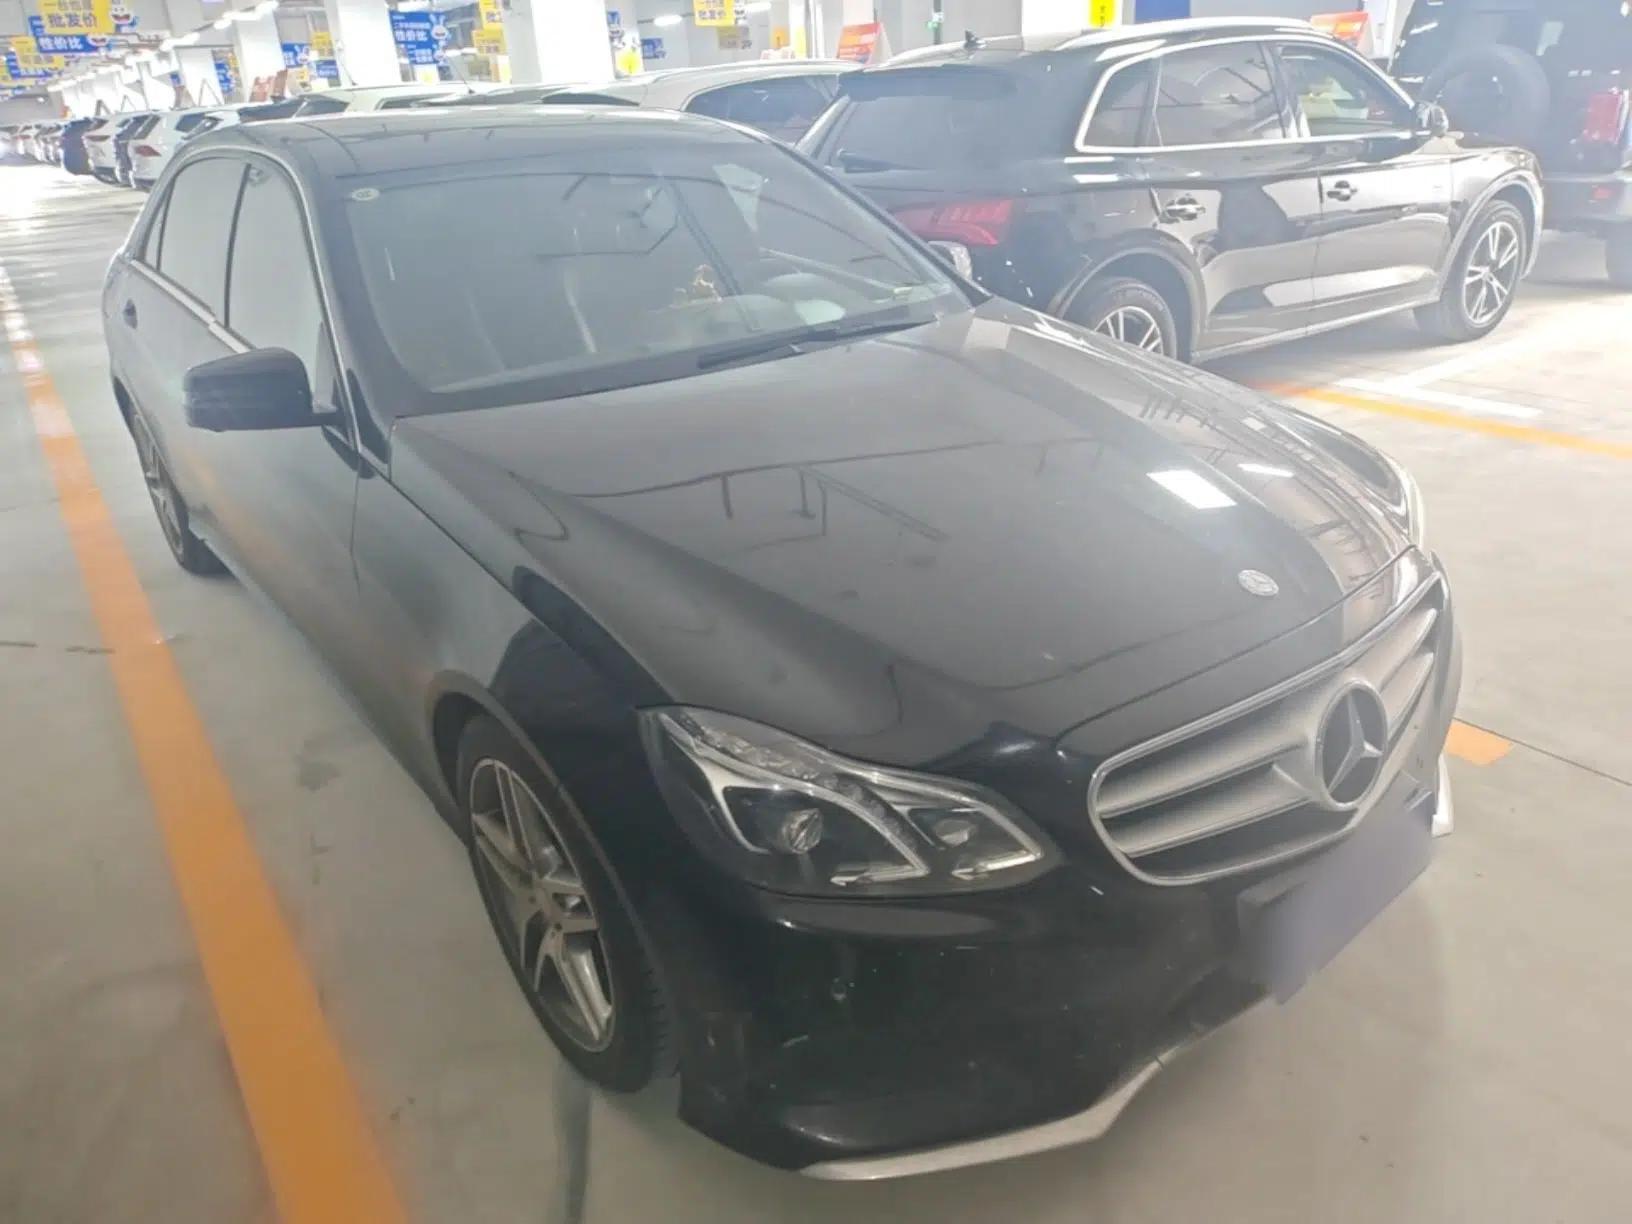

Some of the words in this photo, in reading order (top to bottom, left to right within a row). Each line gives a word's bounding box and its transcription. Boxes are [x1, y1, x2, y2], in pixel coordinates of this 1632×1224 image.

[47, 13, 98, 28] 批发价
[40, 36, 84, 51] 性价比
